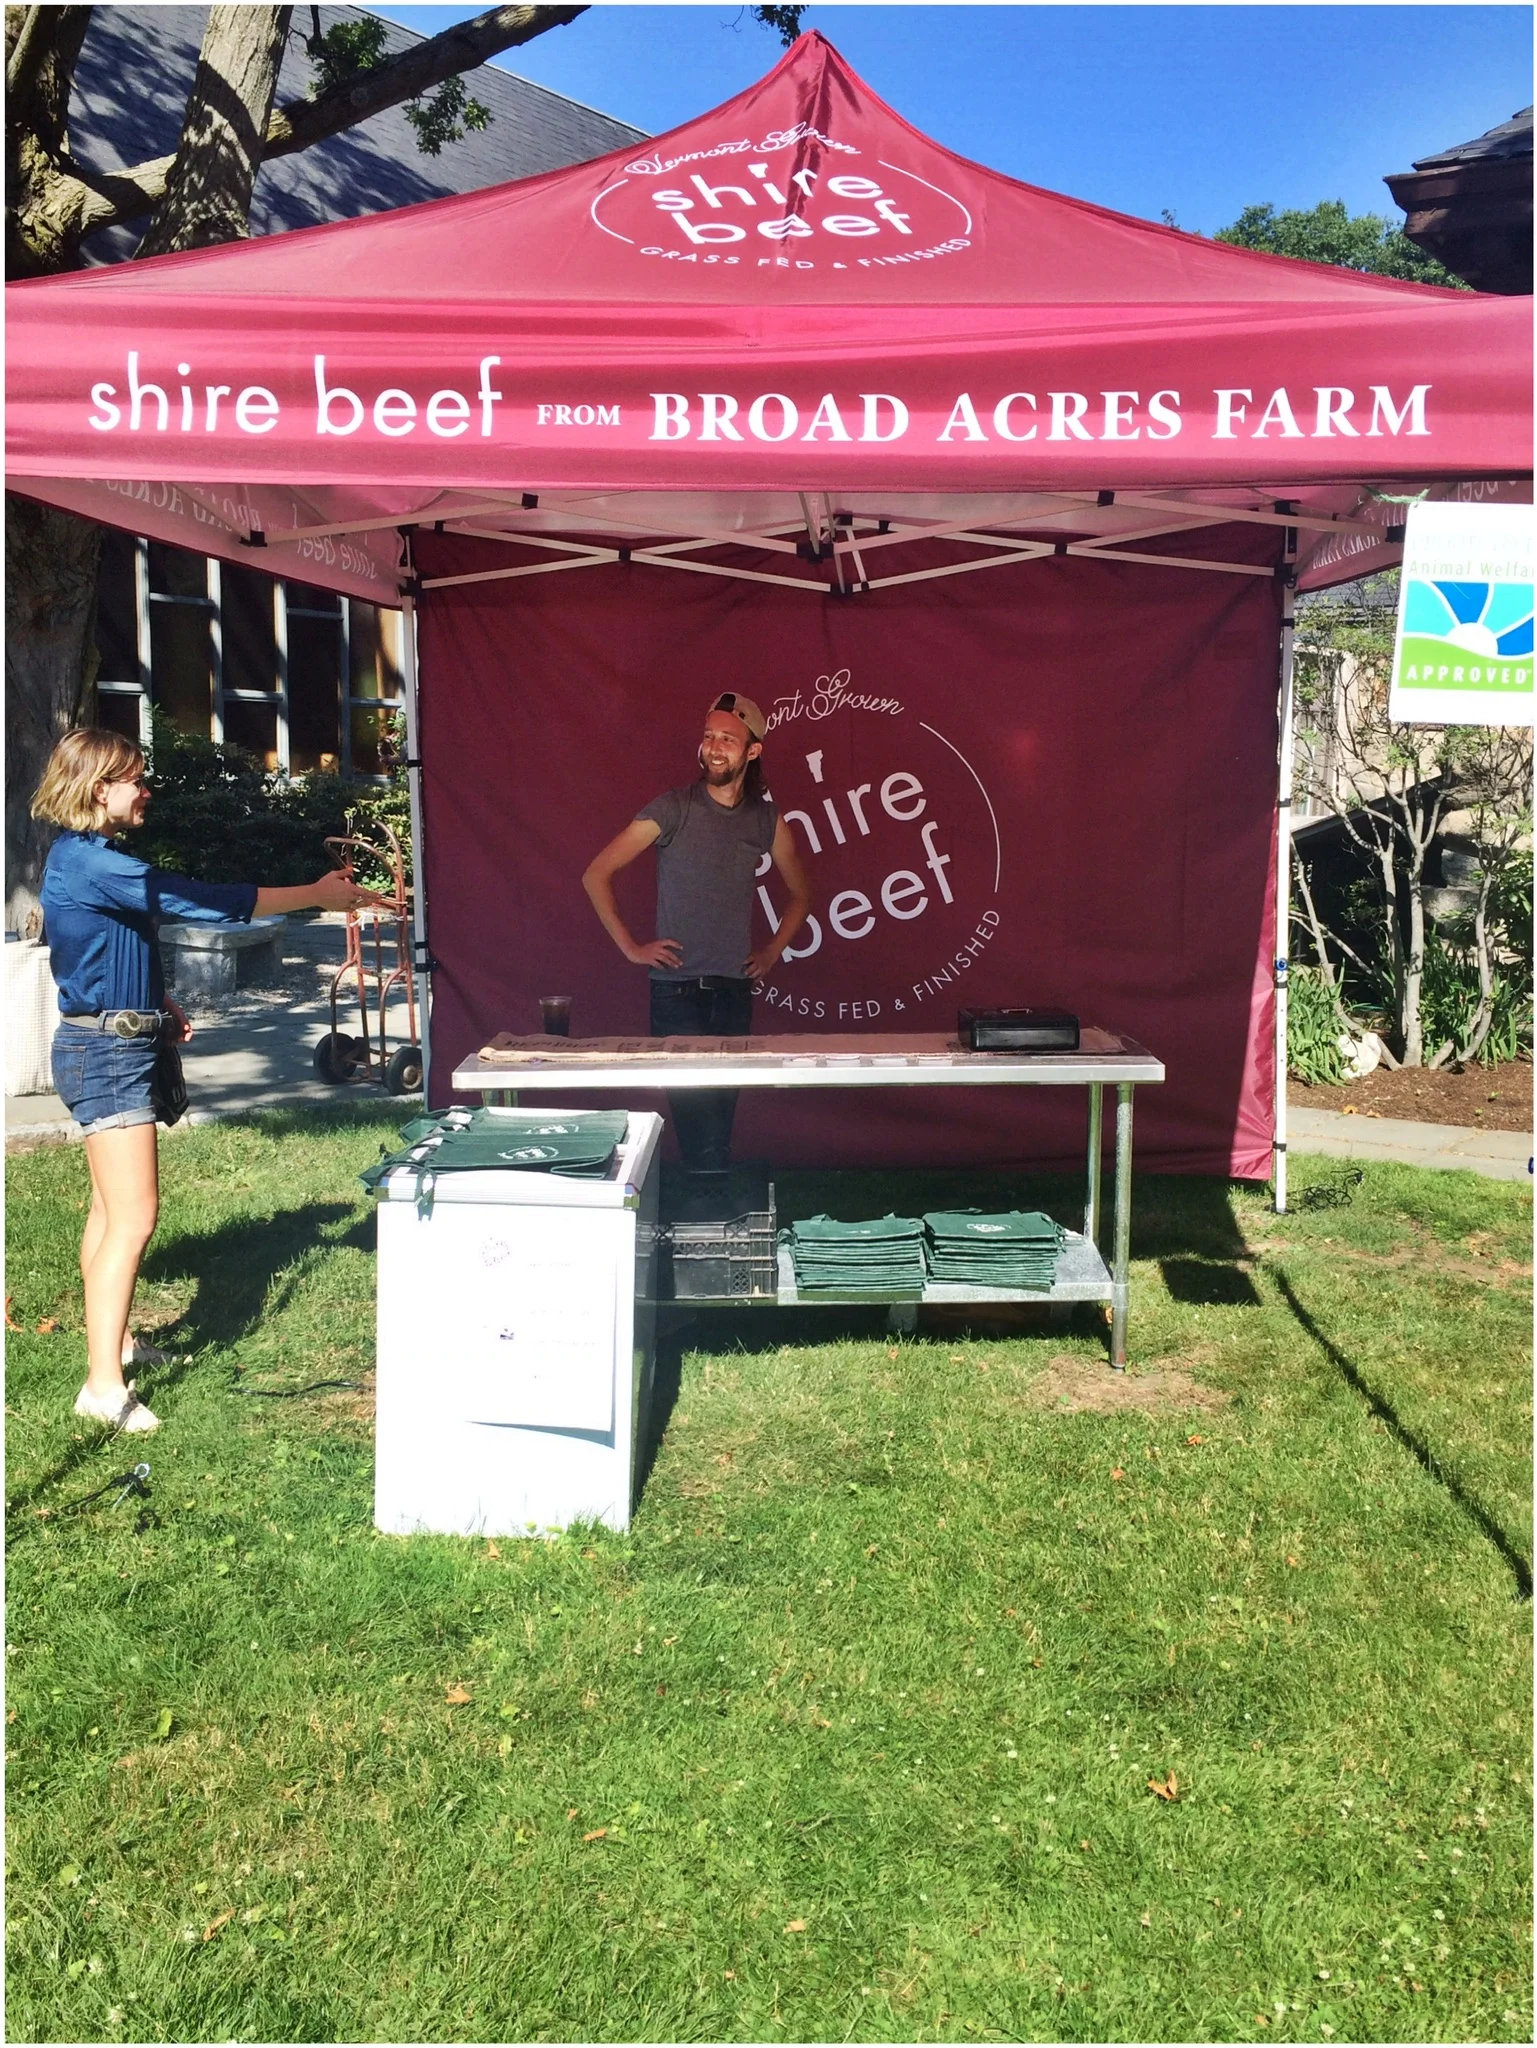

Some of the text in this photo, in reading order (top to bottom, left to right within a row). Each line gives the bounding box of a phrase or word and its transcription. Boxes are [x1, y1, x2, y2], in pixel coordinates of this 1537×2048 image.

[624, 138, 753, 175] Vermont
[651, 163, 884, 213] shire
[671, 199, 913, 245] beef
[639, 237, 972, 269] GRASS FED & FINISHED
[87, 350, 1434, 444] shire beef FROM BROAD ACRES FARM
[1408, 559, 1472, 577] Animal
[806, 668, 905, 721] Grown
[1405, 664, 1528, 685] APPROVED
[756, 820, 955, 963] beef
[750, 909, 1000, 1019] GRASS FED & FINISHED
